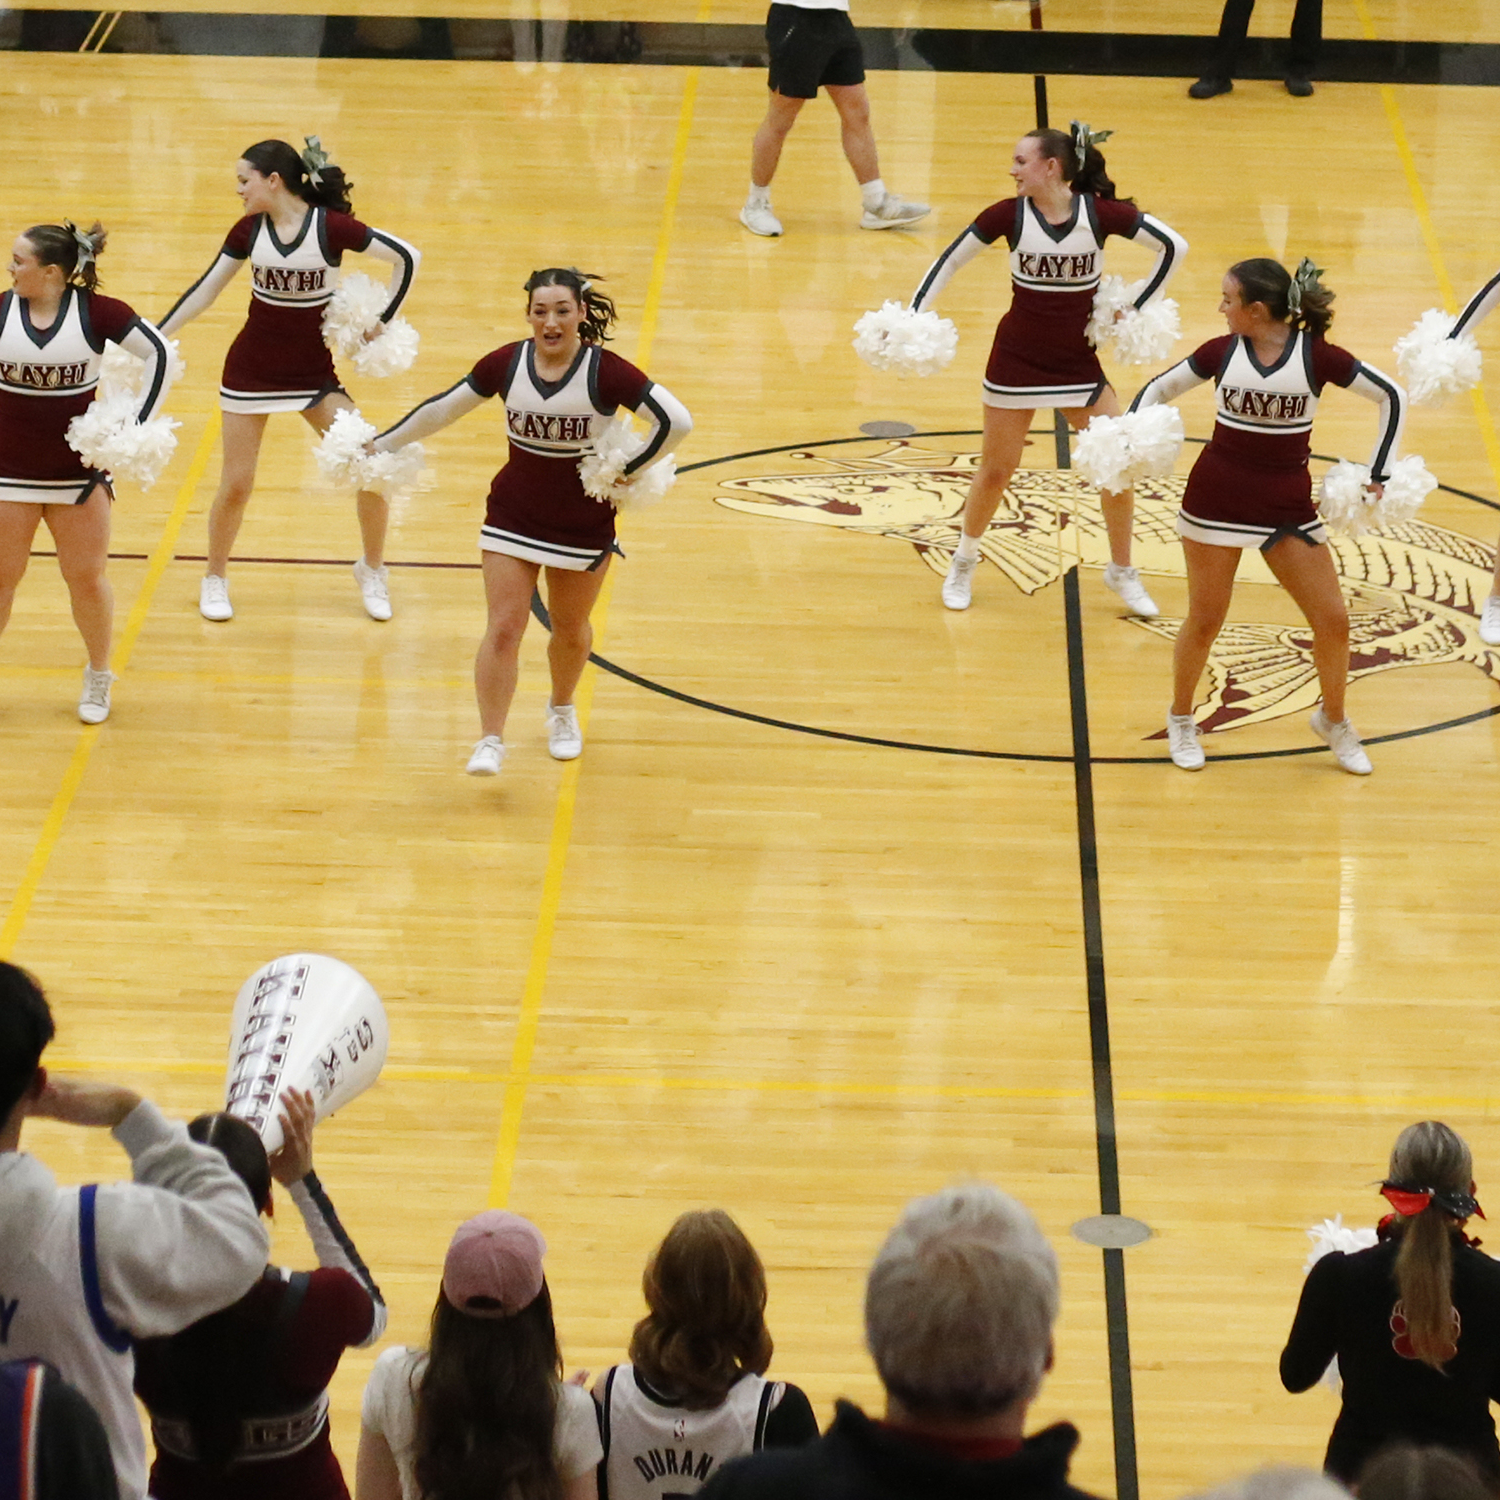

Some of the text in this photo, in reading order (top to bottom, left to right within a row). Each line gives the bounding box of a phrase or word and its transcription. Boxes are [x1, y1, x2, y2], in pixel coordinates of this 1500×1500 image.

[253, 267, 327, 292] KAYHI
[1018, 252, 1096, 278] KAYHI
[1221, 385, 1309, 418] KAYHI
[506, 410, 591, 441] KAYHI
[632, 1447, 716, 1484] DURAN
